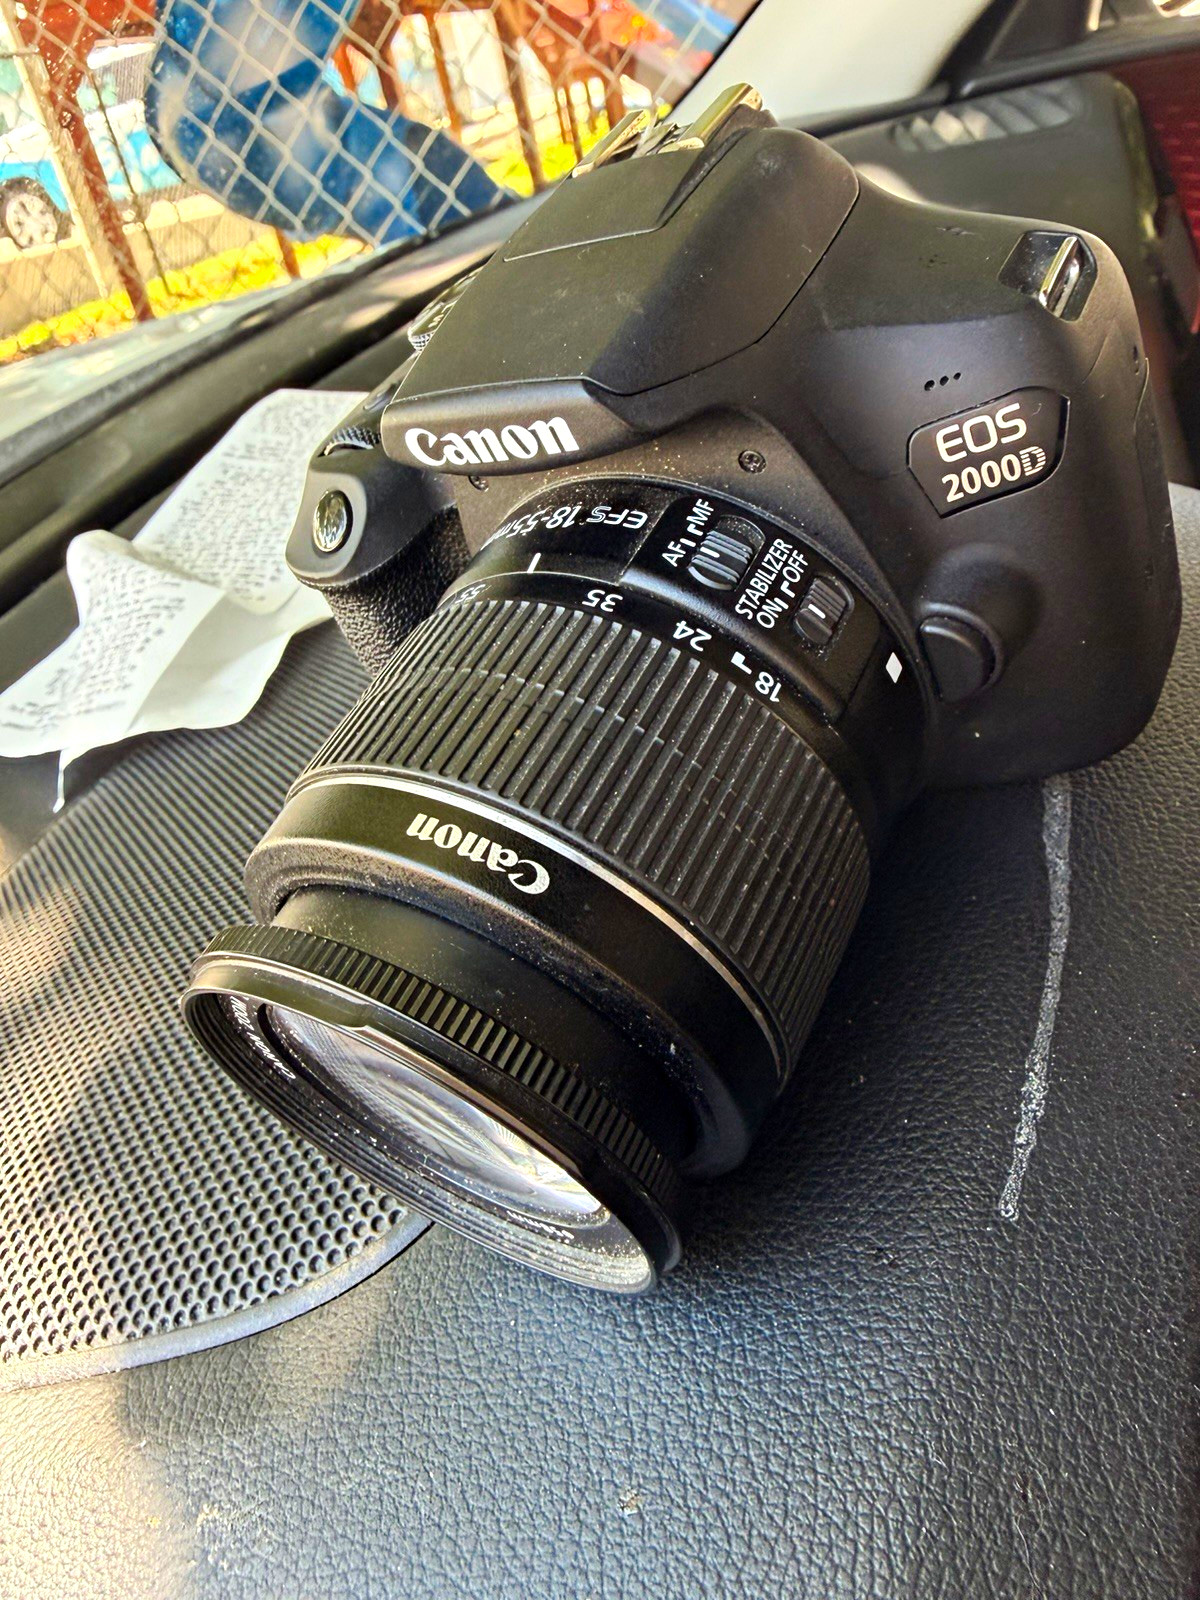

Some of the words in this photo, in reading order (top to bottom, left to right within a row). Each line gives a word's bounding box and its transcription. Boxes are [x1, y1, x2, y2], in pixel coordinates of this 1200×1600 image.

[405, 416, 580, 467] Canon
[935, 403, 1028, 463] EOS
[941, 445, 1047, 503] 2000D
[586, 506, 649, 529] EFS
[661, 540, 687, 567] AF
[686, 498, 714, 526] MF
[582, 589, 623, 613] 35
[735, 538, 793, 620] STABILIZER
[756, 597, 782, 629] ON
[782, 549, 809, 584] OFF
[673, 620, 712, 652] 24
[754, 671, 782, 703] 18
[406, 813, 550, 894] Canon
